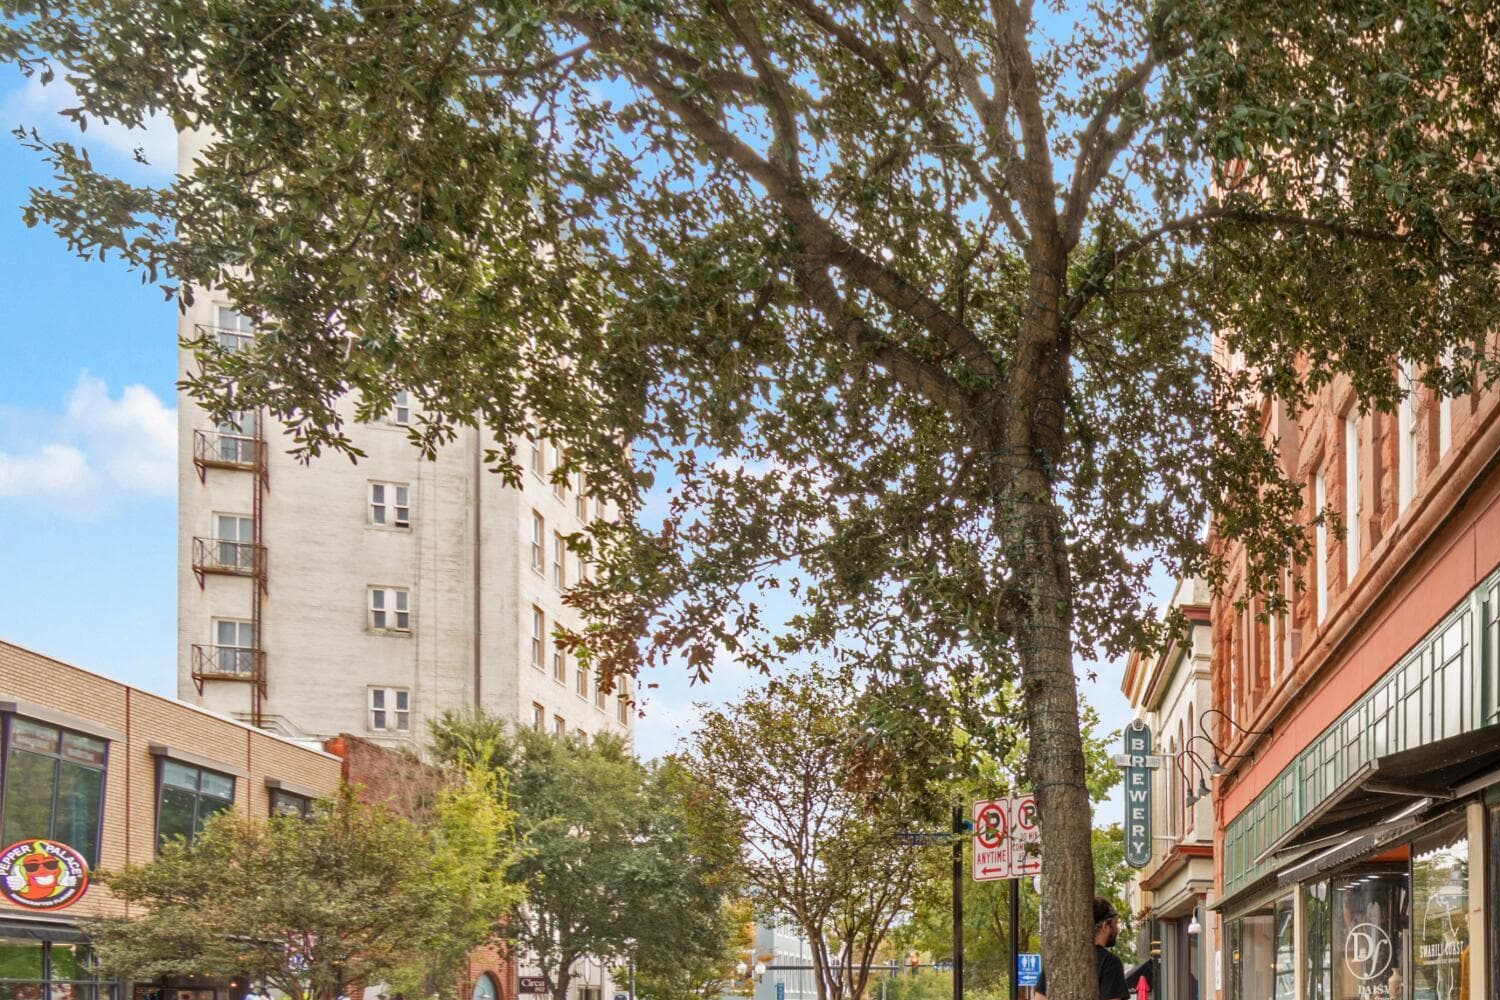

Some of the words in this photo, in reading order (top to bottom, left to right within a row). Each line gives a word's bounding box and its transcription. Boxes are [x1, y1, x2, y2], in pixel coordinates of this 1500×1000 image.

[1128, 738, 1147, 855] BREWERY
[0, 845, 32, 876] PEPPER
[46, 844, 83, 878] PALACE
[976, 850, 1006, 865] ANYTIME
[1420, 943, 1443, 958] SWAHILI
[1445, 940, 1464, 956] COAST
[521, 979, 545, 987] Circa
